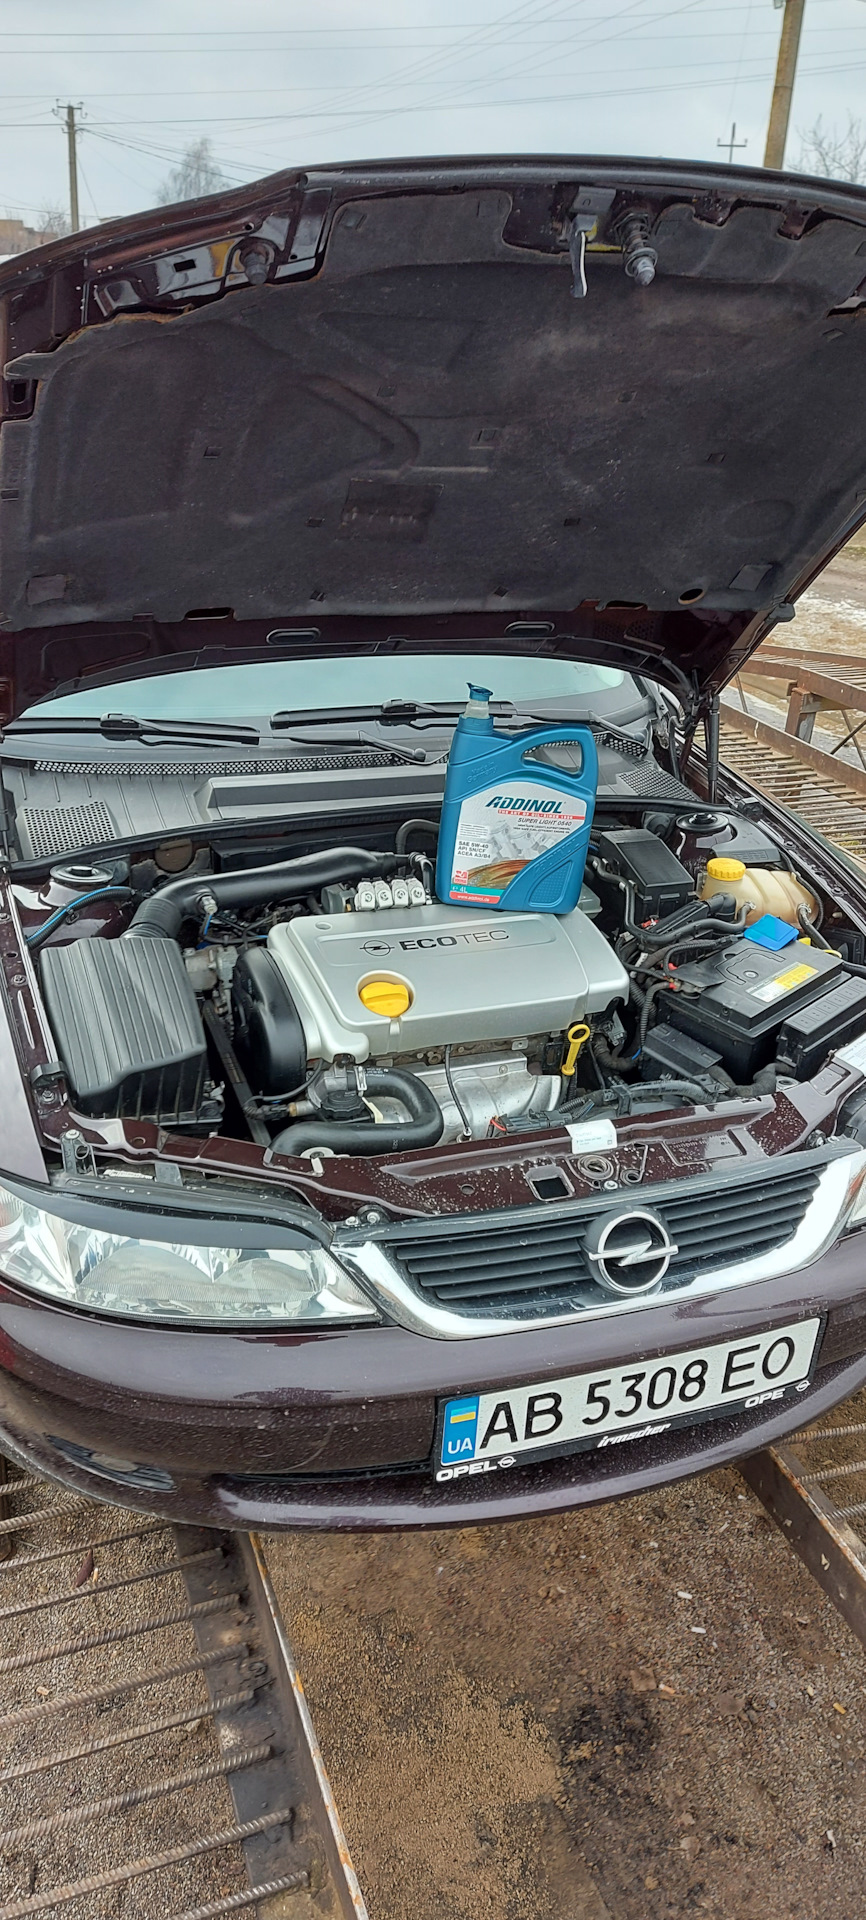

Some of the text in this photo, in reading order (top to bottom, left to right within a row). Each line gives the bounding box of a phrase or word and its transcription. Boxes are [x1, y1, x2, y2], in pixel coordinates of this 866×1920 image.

[485, 796, 564, 814] ADDINOL
[398, 930, 510, 951] ECOTEC
[478, 1336, 795, 1450] AB 5308 EO
[447, 1437, 473, 1454] UA
[597, 1423, 672, 1448] irmscher
[436, 1461, 497, 1482] OPEL
